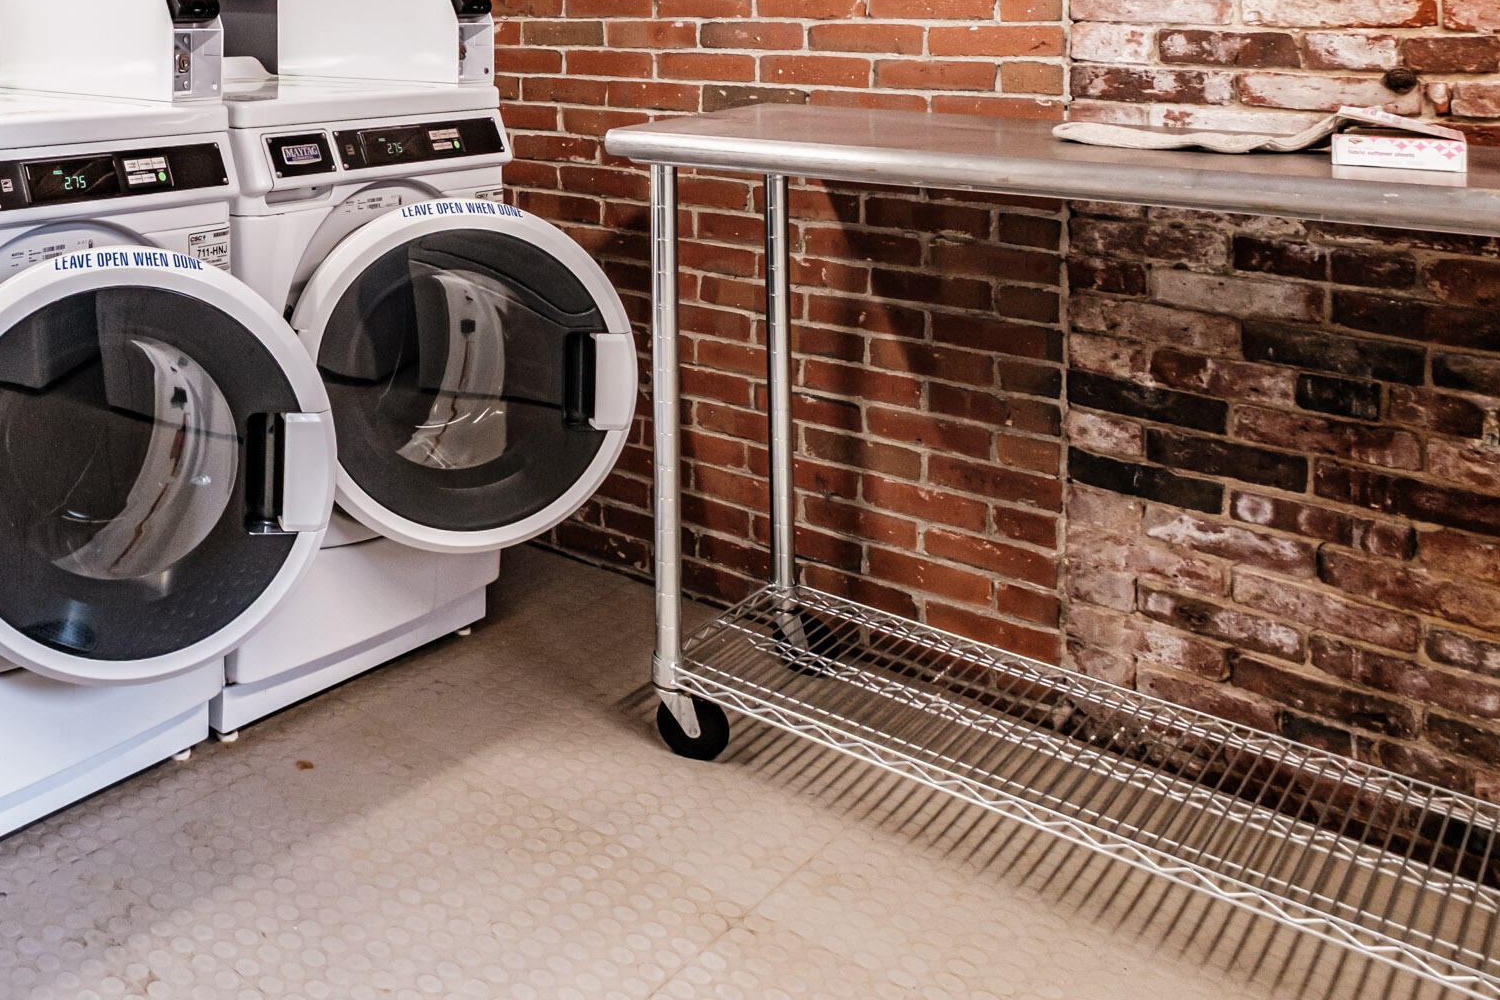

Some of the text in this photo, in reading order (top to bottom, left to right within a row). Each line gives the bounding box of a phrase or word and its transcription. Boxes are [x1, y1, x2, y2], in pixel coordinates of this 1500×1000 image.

[285, 145, 318, 159] MAYTAG
[401, 202, 524, 218] LEAVE OPEN WHEN DONE
[190, 235, 203, 243] CSC
[197, 244, 228, 259] 711-HNJ
[54, 251, 204, 271] LEAVE OPEN WHEN DONE
